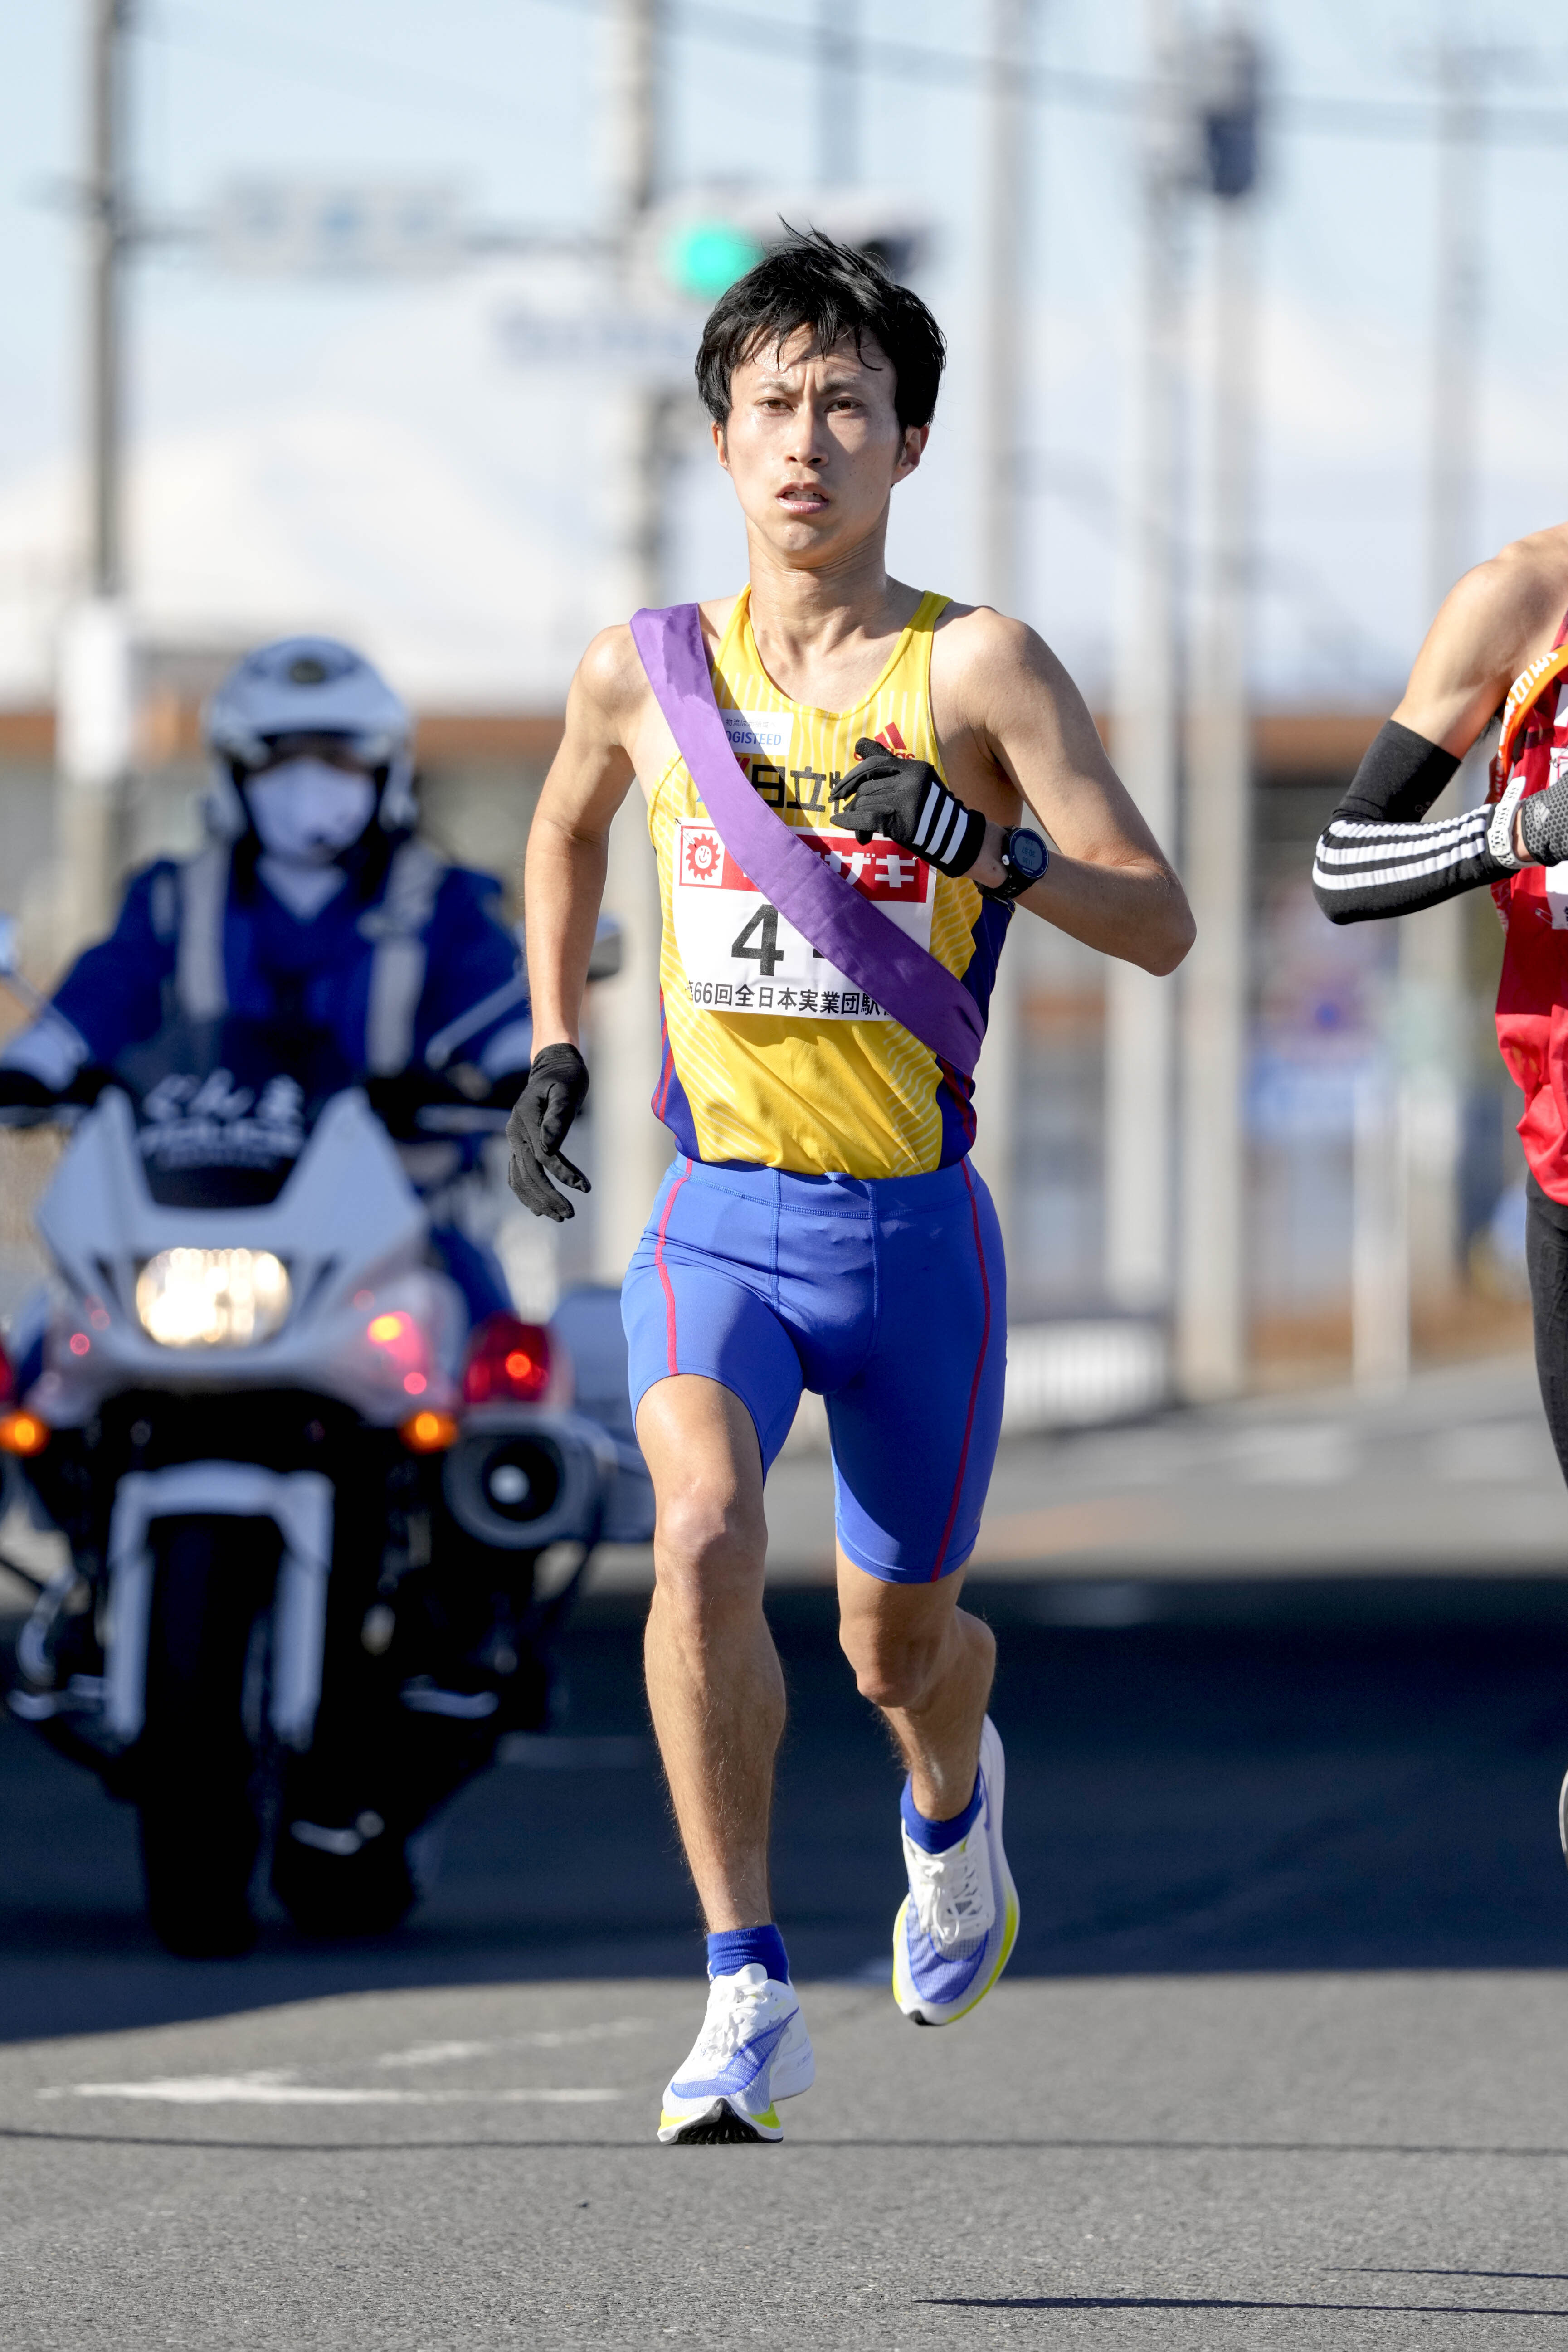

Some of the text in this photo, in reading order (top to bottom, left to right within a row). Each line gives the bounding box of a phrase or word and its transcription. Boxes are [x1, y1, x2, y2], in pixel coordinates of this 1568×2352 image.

[688, 981, 891, 1016] 66回全日本実業団駅
